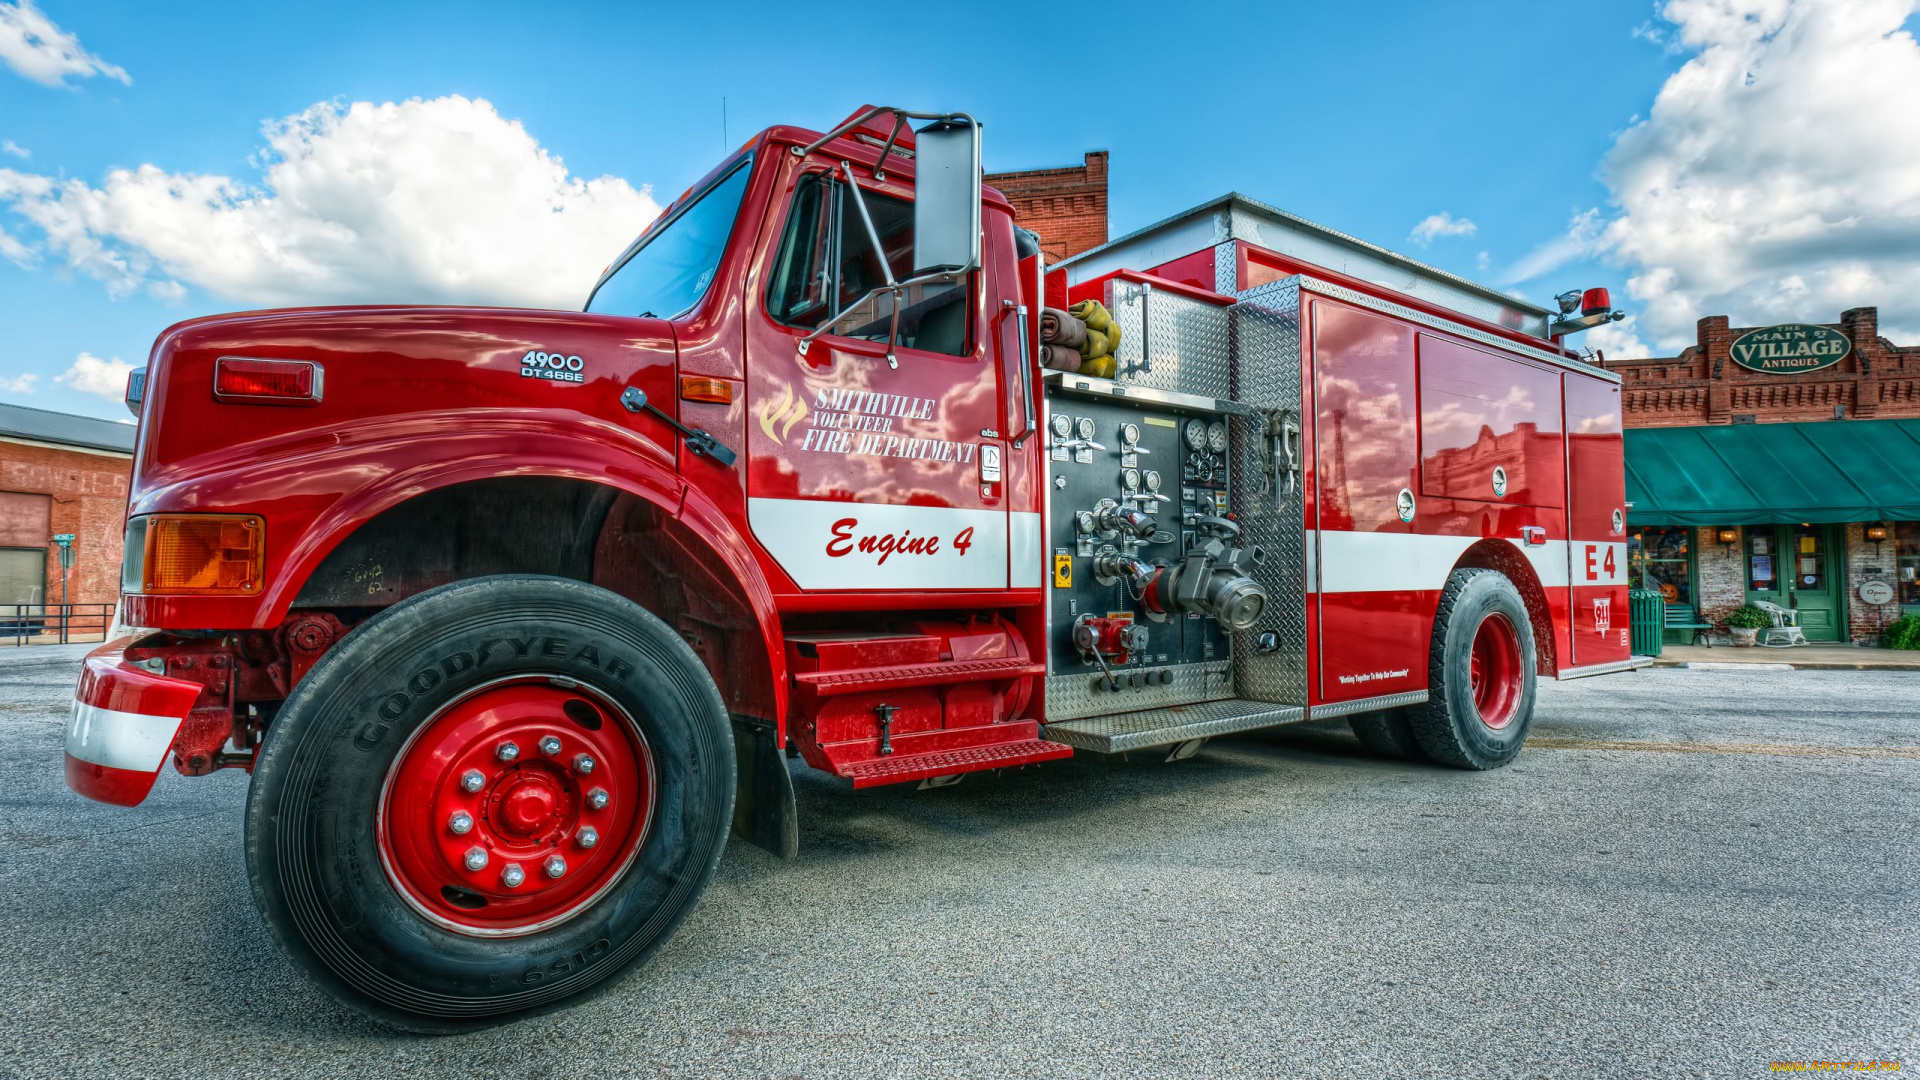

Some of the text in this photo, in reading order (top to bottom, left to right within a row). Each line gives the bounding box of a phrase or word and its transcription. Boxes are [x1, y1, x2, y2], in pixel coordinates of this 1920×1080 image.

[1752, 331, 1806, 341] MAIN
[521, 350, 584, 372] 4900
[1737, 340, 1843, 363] VILLAGE
[1762, 358, 1819, 368] ANTIQUES
[521, 367, 584, 382] DT 466E
[814, 386, 936, 421] SMITHVILLE
[812, 411, 893, 433] VOLUNTEER
[981, 429, 999, 438] abs
[800, 428, 977, 464] FIRE DEPARTMENT
[825, 517, 974, 566] Engine 4
[1585, 545, 1616, 580] E 4
[1866, 589, 1886, 597] Open
[1596, 605, 1608, 623] 911
[354, 636, 636, 751] GOODYEAR
